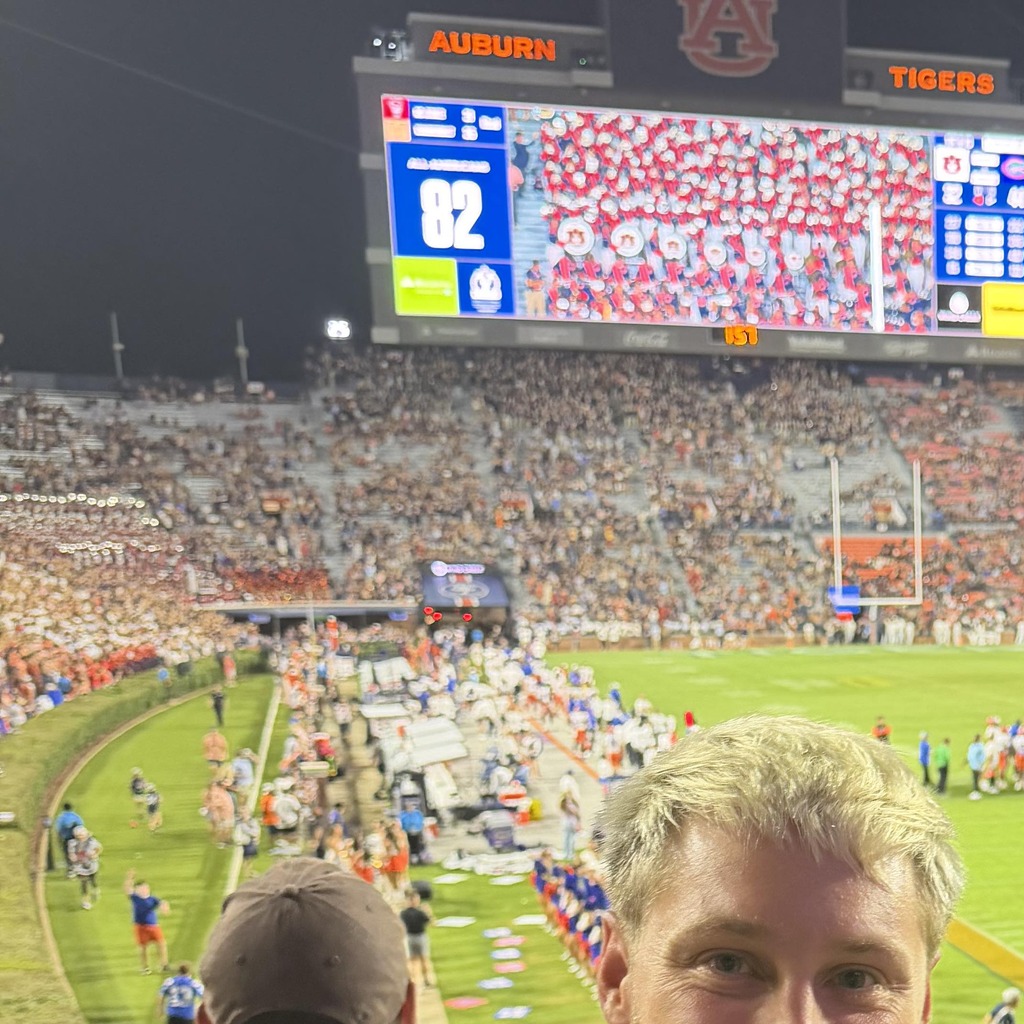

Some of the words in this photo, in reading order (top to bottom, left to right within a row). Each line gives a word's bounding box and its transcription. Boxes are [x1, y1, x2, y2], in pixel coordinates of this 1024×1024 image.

[429, 30, 556, 61] AUBURN
[889, 66, 995, 95] TIGERS
[420, 178, 485, 250] 82
